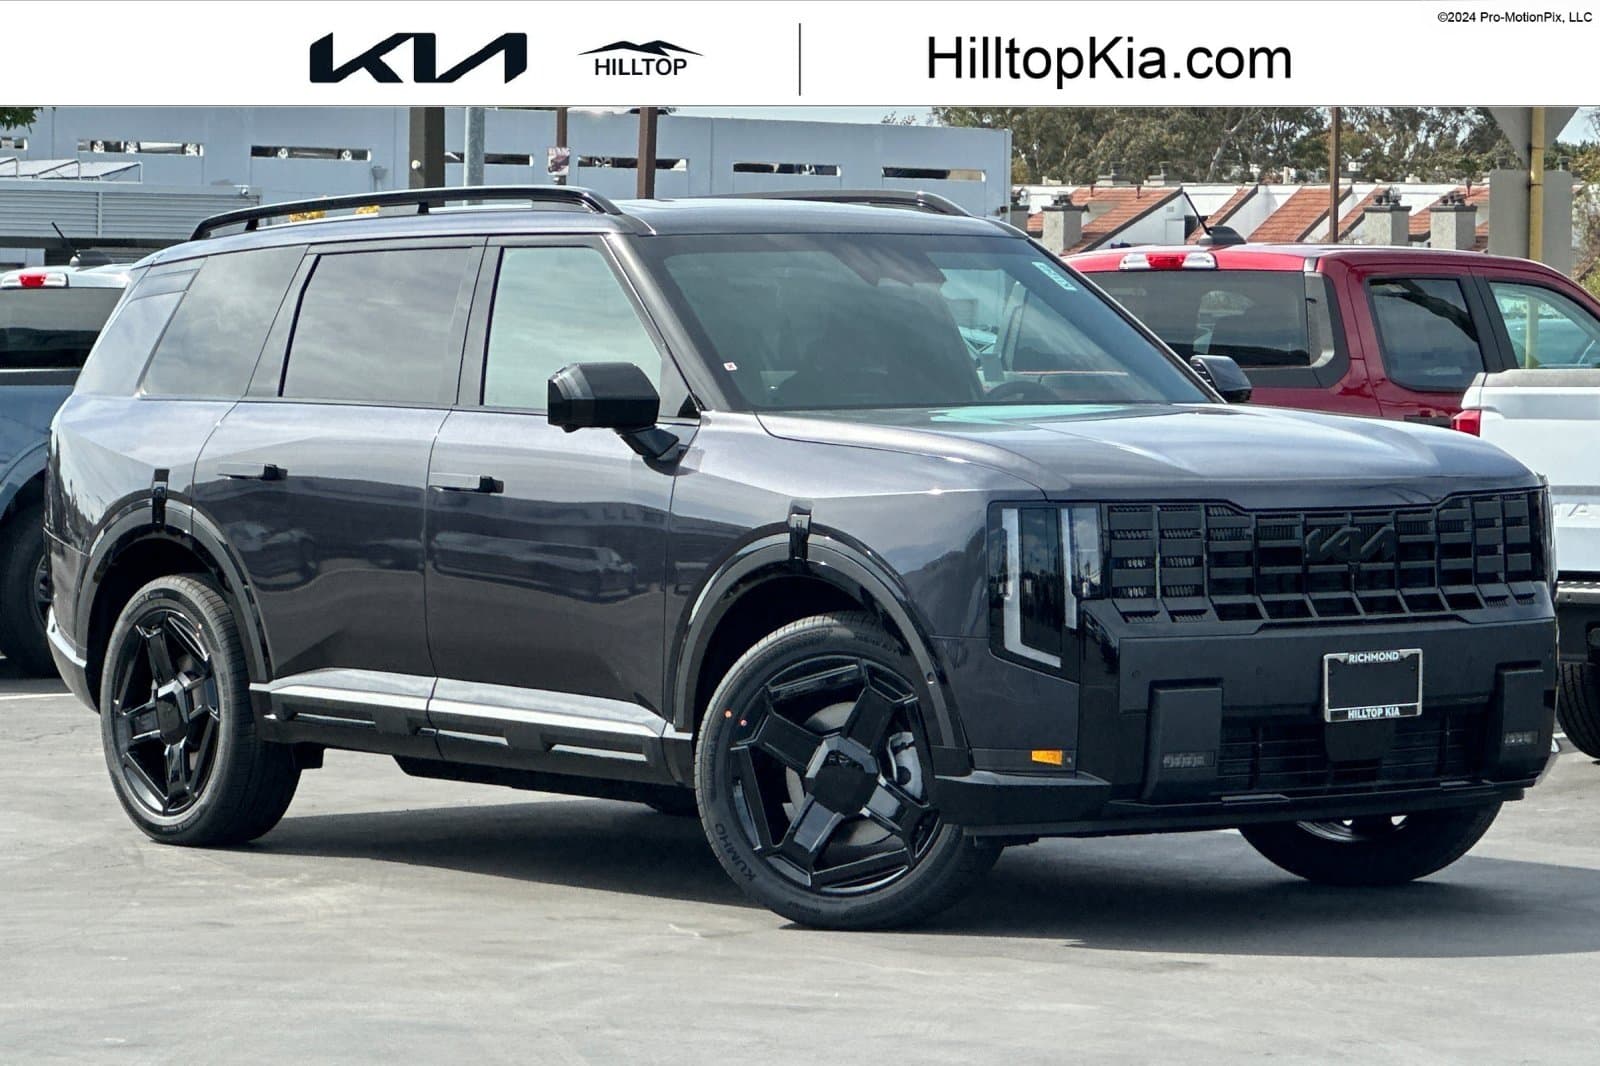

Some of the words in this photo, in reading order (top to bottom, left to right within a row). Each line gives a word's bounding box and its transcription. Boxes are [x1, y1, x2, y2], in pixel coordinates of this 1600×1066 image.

[1348, 651, 1400, 663] RICHMOND
[1347, 708, 1384, 719] HILLTOP
[1385, 706, 1401, 717] KIA
[714, 823, 756, 881] KUMHO
